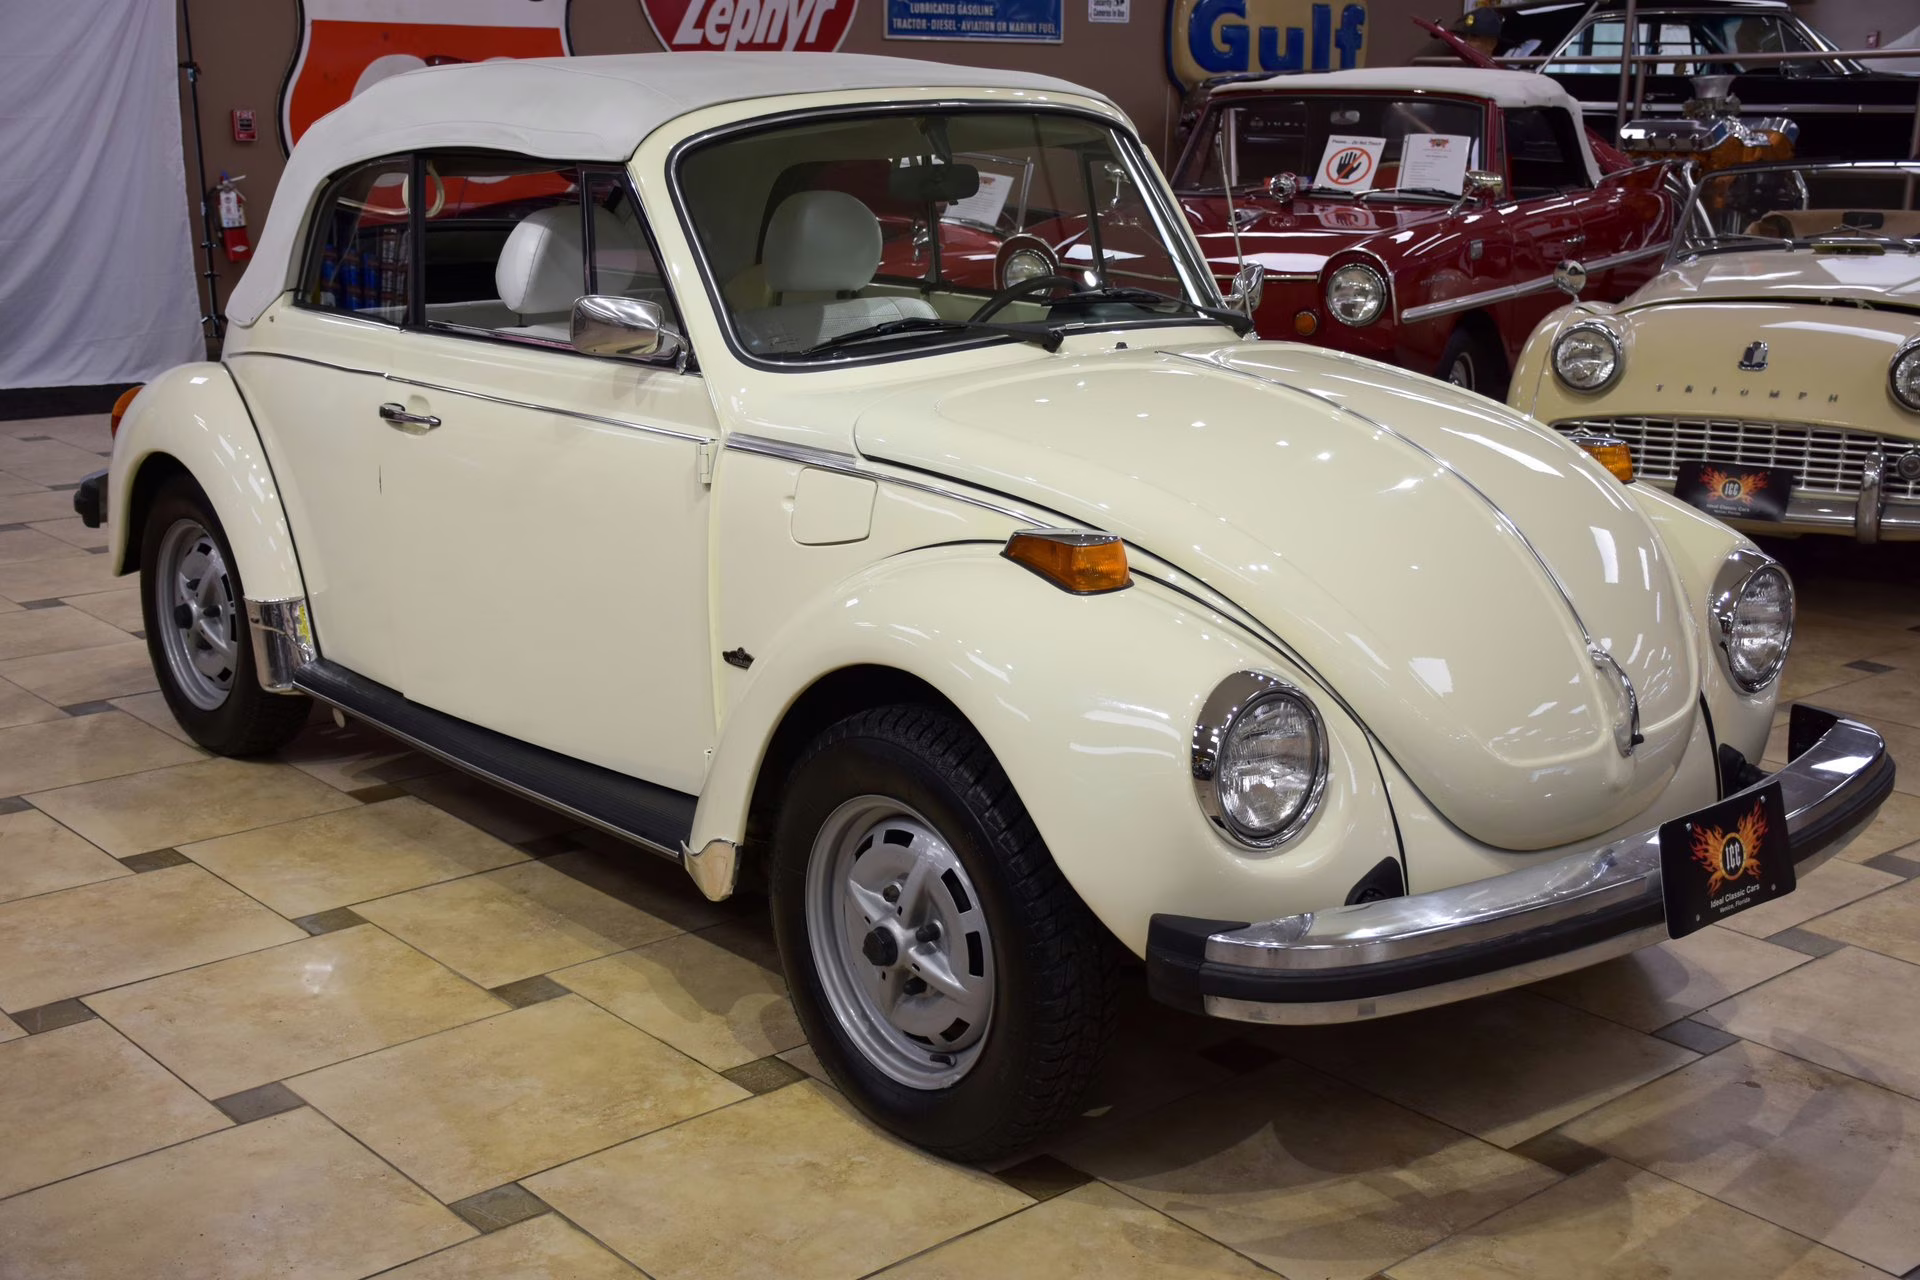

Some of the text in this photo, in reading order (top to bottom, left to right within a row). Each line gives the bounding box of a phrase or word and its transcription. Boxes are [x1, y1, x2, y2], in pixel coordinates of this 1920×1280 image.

[909, 2, 994, 16] LUBRICATED GASOLINE
[672, 0, 836, 51] Zephyr
[996, 21, 1007, 32] OR
[1009, 22, 1037, 33] MARINE
[1189, 0, 1366, 73] Gulf
[1656, 383, 1838, 402] TRIUMPH
[1710, 883, 1760, 909] Ideal Classic Cars
